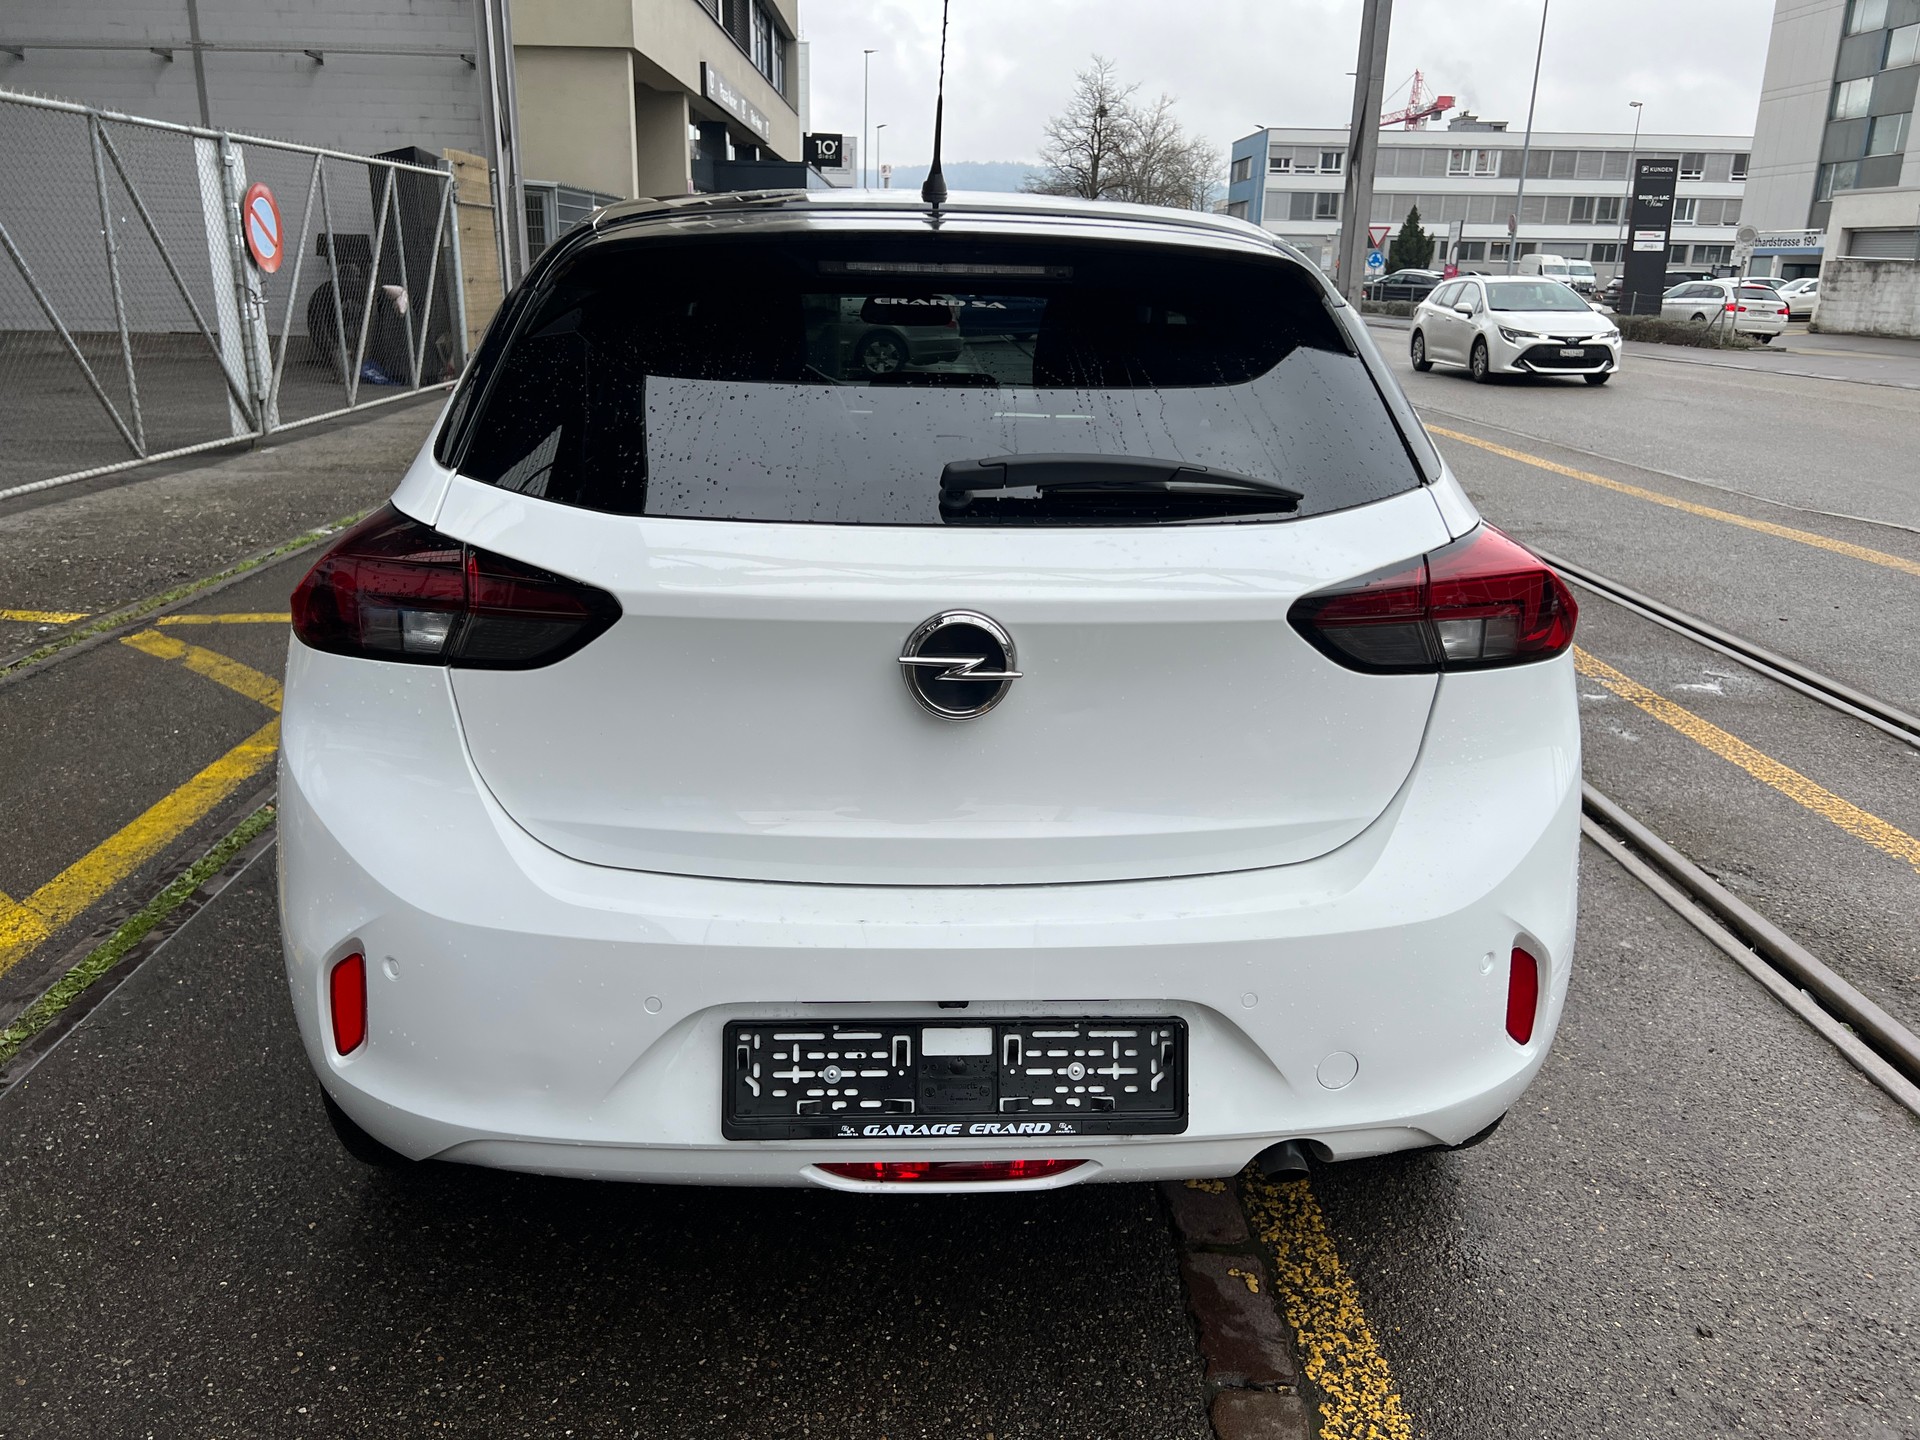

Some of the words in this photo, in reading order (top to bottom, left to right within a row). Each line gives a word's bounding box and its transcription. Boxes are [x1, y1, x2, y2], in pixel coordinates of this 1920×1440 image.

[1803, 235, 1818, 247] 190
[874, 297, 966, 307] ERARD
[971, 300, 1007, 309] SA
[862, 1123, 963, 1136] GARAGE
[968, 1122, 1052, 1135] ERARD
